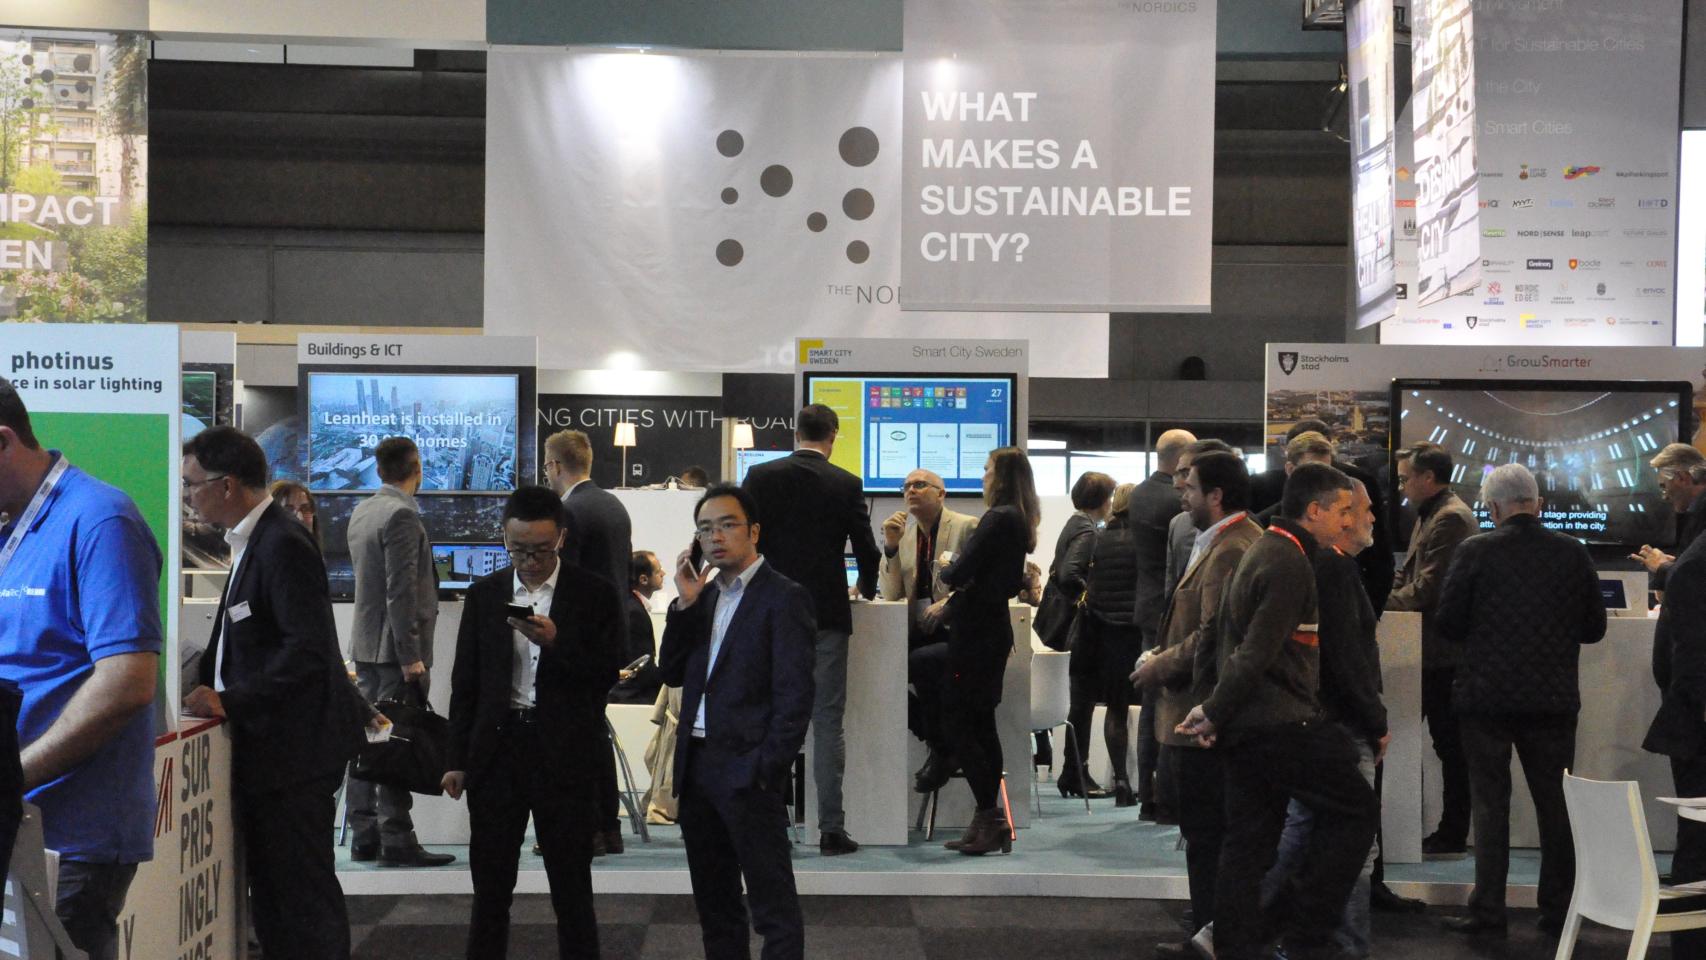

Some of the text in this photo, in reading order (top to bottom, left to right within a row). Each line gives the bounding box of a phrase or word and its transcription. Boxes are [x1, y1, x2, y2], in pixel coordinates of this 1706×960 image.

[1132, 1, 1197, 13] NORDICS
[1513, 37, 1600, 52] Sustainable
[1603, 36, 1645, 52] Cities
[1511, 79, 1543, 96] City
[921, 91, 1037, 122] WHAT
[1485, 120, 1573, 135] Smart Cities
[922, 138, 1098, 169] MAKES A
[920, 185, 1192, 216] SUSTAINABLE
[0, 195, 119, 226] PACT
[920, 231, 1030, 262] CITY?
[1421, 217, 1448, 259] CITY
[828, 284, 902, 304] THE NO
[307, 343, 403, 359] Buildings & ICT
[912, 345, 1023, 360] Smart City Sweden
[1301, 354, 1349, 363] Stockholms
[11, 351, 114, 373] photinus
[1506, 355, 1592, 367] GrowSmarter
[34, 376, 49, 390] in
[54, 376, 96, 391] solar
[100, 377, 162, 393] lighting
[991, 388, 1002, 398] 27
[324, 411, 502, 426] Leanheat is installed in
[580, 408, 655, 428] CITIES
[415, 434, 468, 449] homes
[1544, 511, 1567, 520] stage
[1568, 511, 1607, 520] providing
[1565, 521, 1573, 529] in
[1575, 521, 1588, 529] the
[1590, 522, 1606, 531] city.
[181, 733, 211, 803] SUR
[180, 799, 214, 875] PRIS
[178, 859, 222, 946] INGLY
